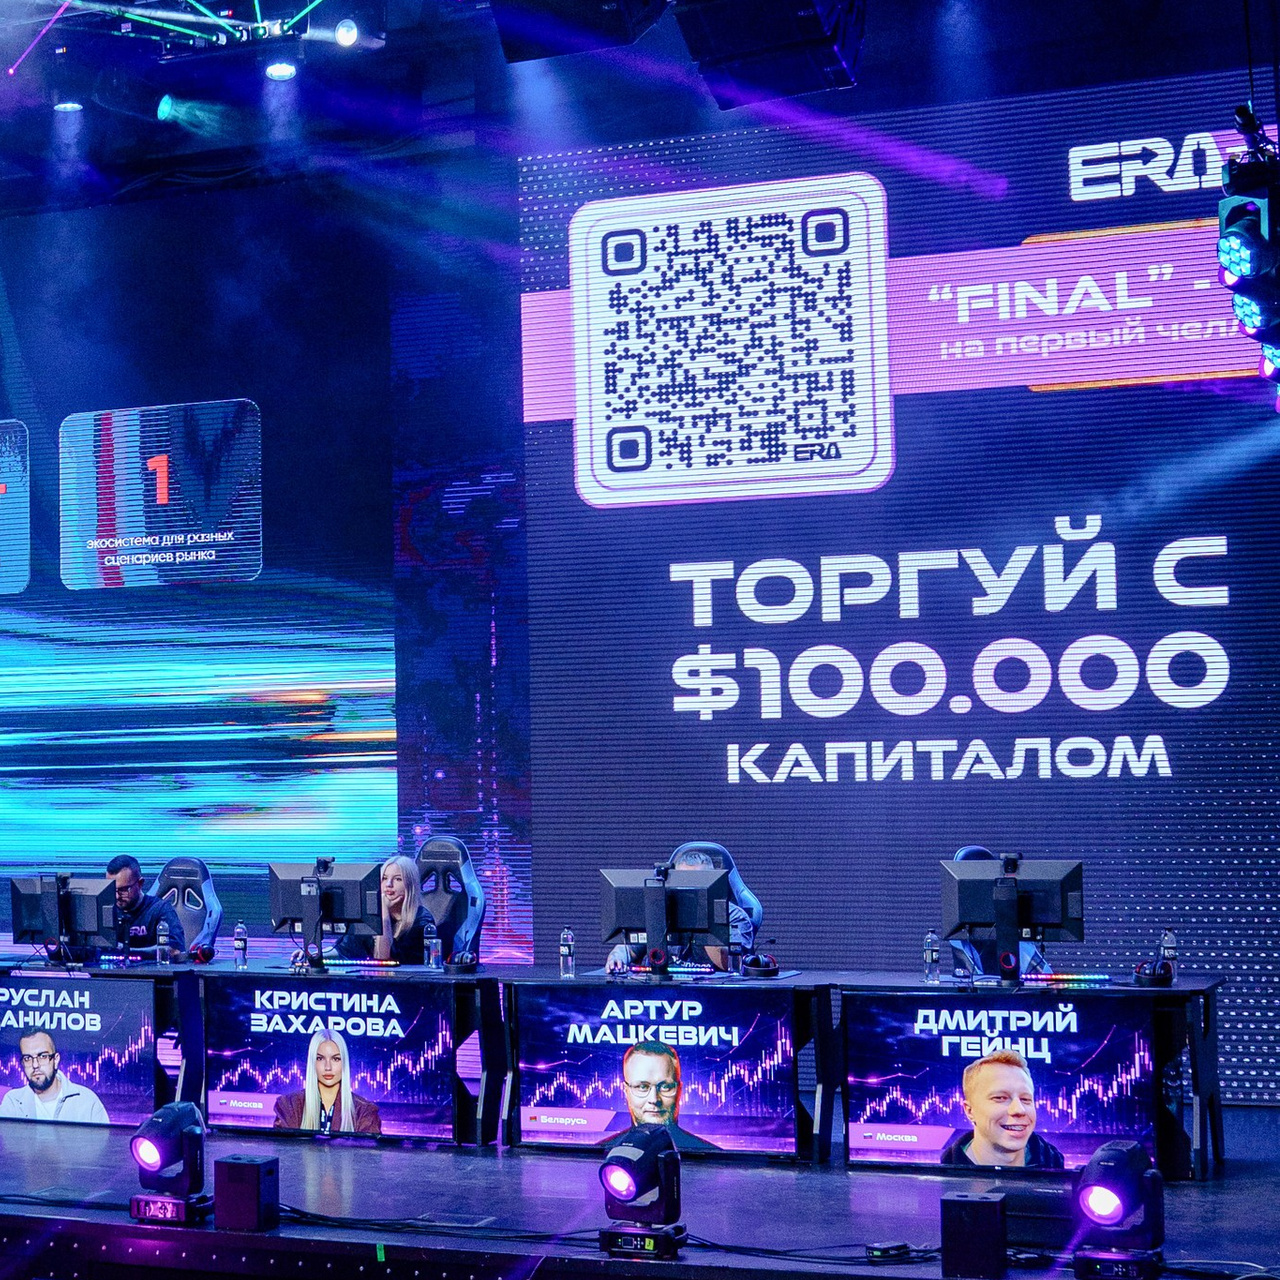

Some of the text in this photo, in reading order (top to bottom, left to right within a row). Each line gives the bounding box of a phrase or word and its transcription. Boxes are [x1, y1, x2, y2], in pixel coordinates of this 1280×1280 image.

[1069, 132, 1223, 202] ERA
[940, 340, 985, 360] на
[995, 317, 1146, 357] первый
[794, 442, 842, 461] ERA
[147, 455, 170, 505] 1
[86, 530, 235, 550] экосистема для разных
[104, 549, 216, 566] сценариев рынка
[669, 515, 1118, 627] ТОРГУЙ
[671, 630, 1231, 721] $100.000
[727, 735, 1173, 784] КАПИТАЛОМ
[254, 990, 401, 1014] КРИСТИНА
[600, 999, 703, 1021] АРТУР
[250, 1012, 405, 1038] ЗАХАРОВА
[913, 1003, 1078, 1035] ДМИТРИЙ
[566, 1023, 739, 1047] МАЦКЕВИЧ
[941, 1028, 1052, 1064] ГЕЙНЦ
[229, 1099, 264, 1109] Москва
[540, 1115, 588, 1125] Беларусь
[876, 1132, 918, 1143] Москва
